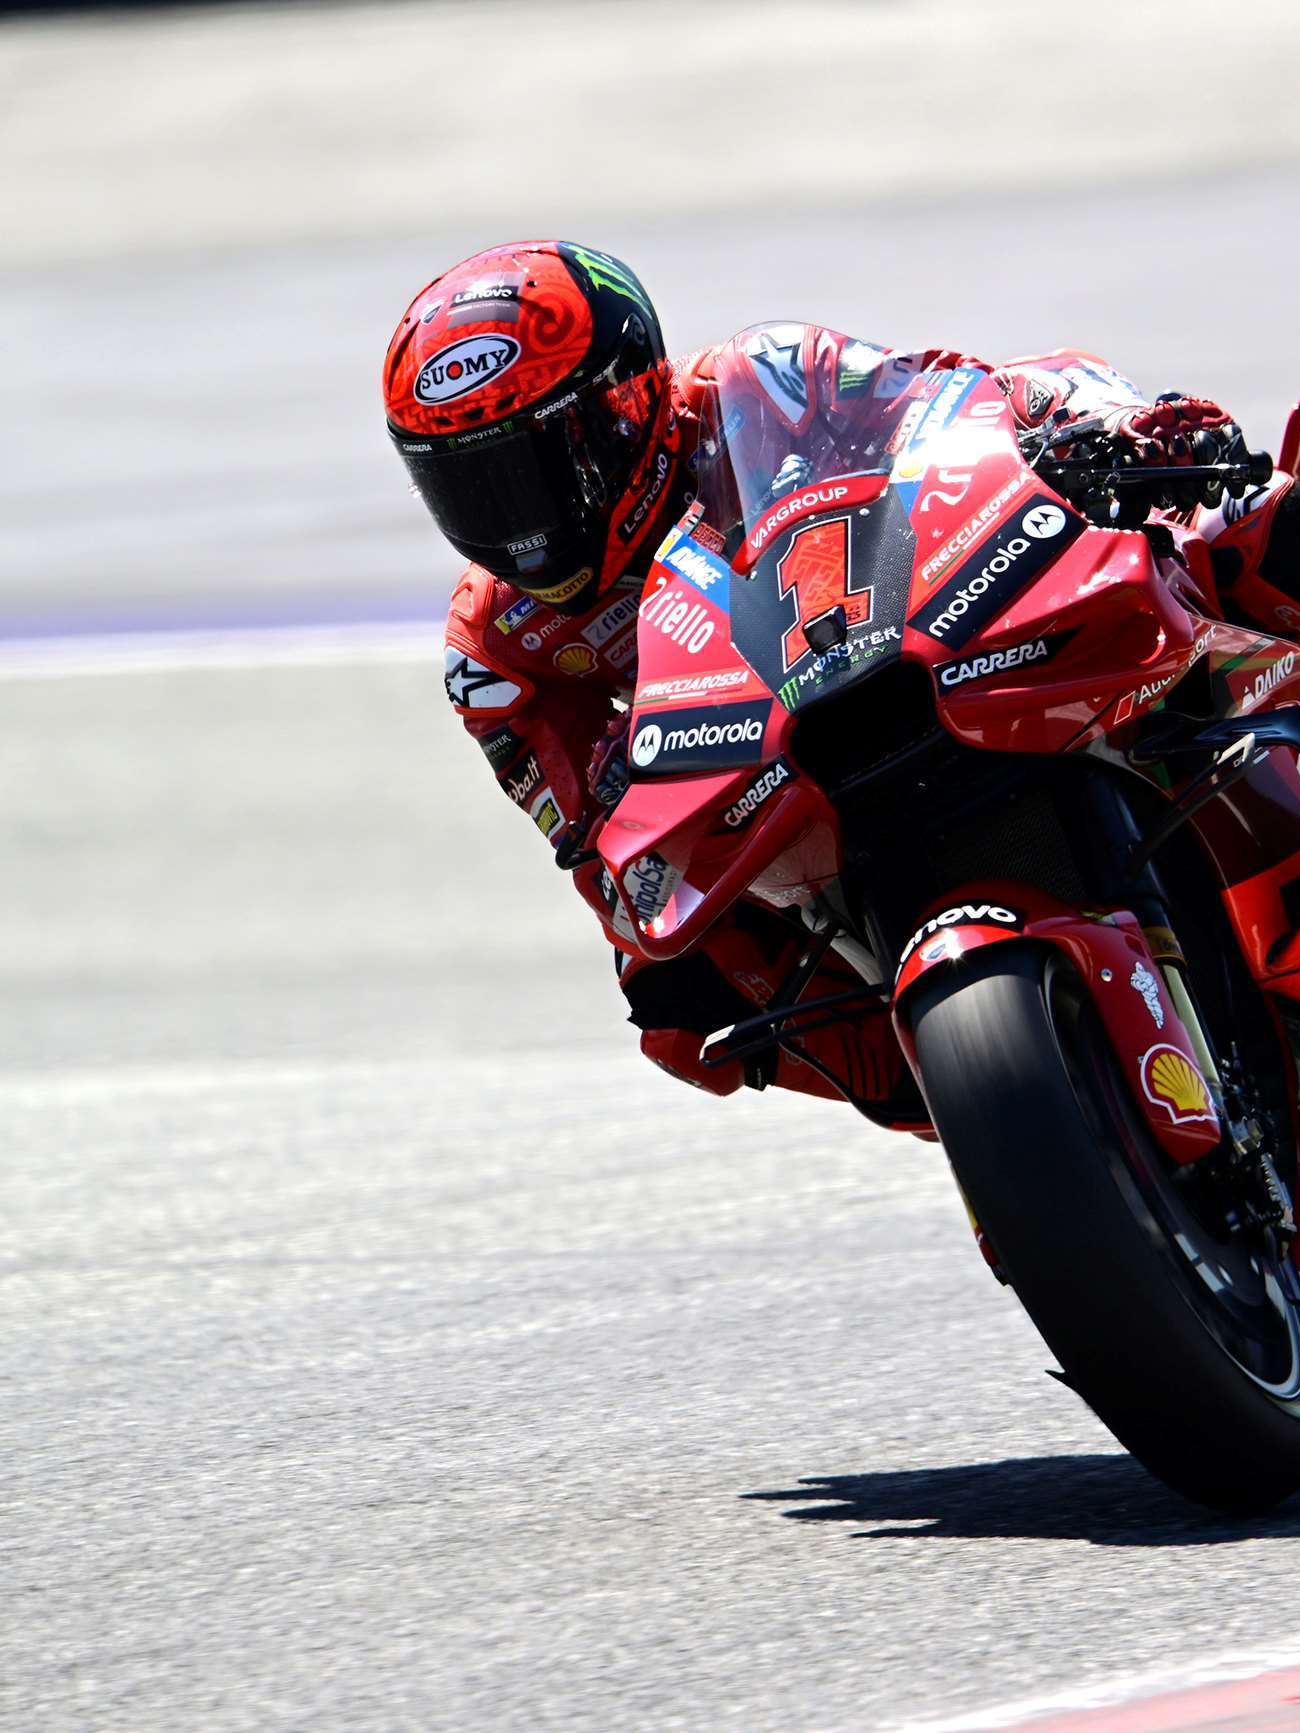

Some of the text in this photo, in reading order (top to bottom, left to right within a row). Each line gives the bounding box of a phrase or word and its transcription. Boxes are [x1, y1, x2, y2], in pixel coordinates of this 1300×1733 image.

[420, 348, 507, 391] SUOMY
[534, 391, 578, 420] CARRERA
[457, 427, 502, 443] MONSTER
[624, 453, 668, 533] Lenovo
[511, 537, 544, 552] FASSI
[777, 515, 874, 674] 1
[929, 538, 1032, 638] motorola
[799, 626, 902, 687] MONSTER
[940, 640, 1048, 686] CARRERA
[637, 669, 750, 698] FRECCIAROSSA
[664, 718, 763, 751] motorola
[724, 763, 790, 828] CARRERA
